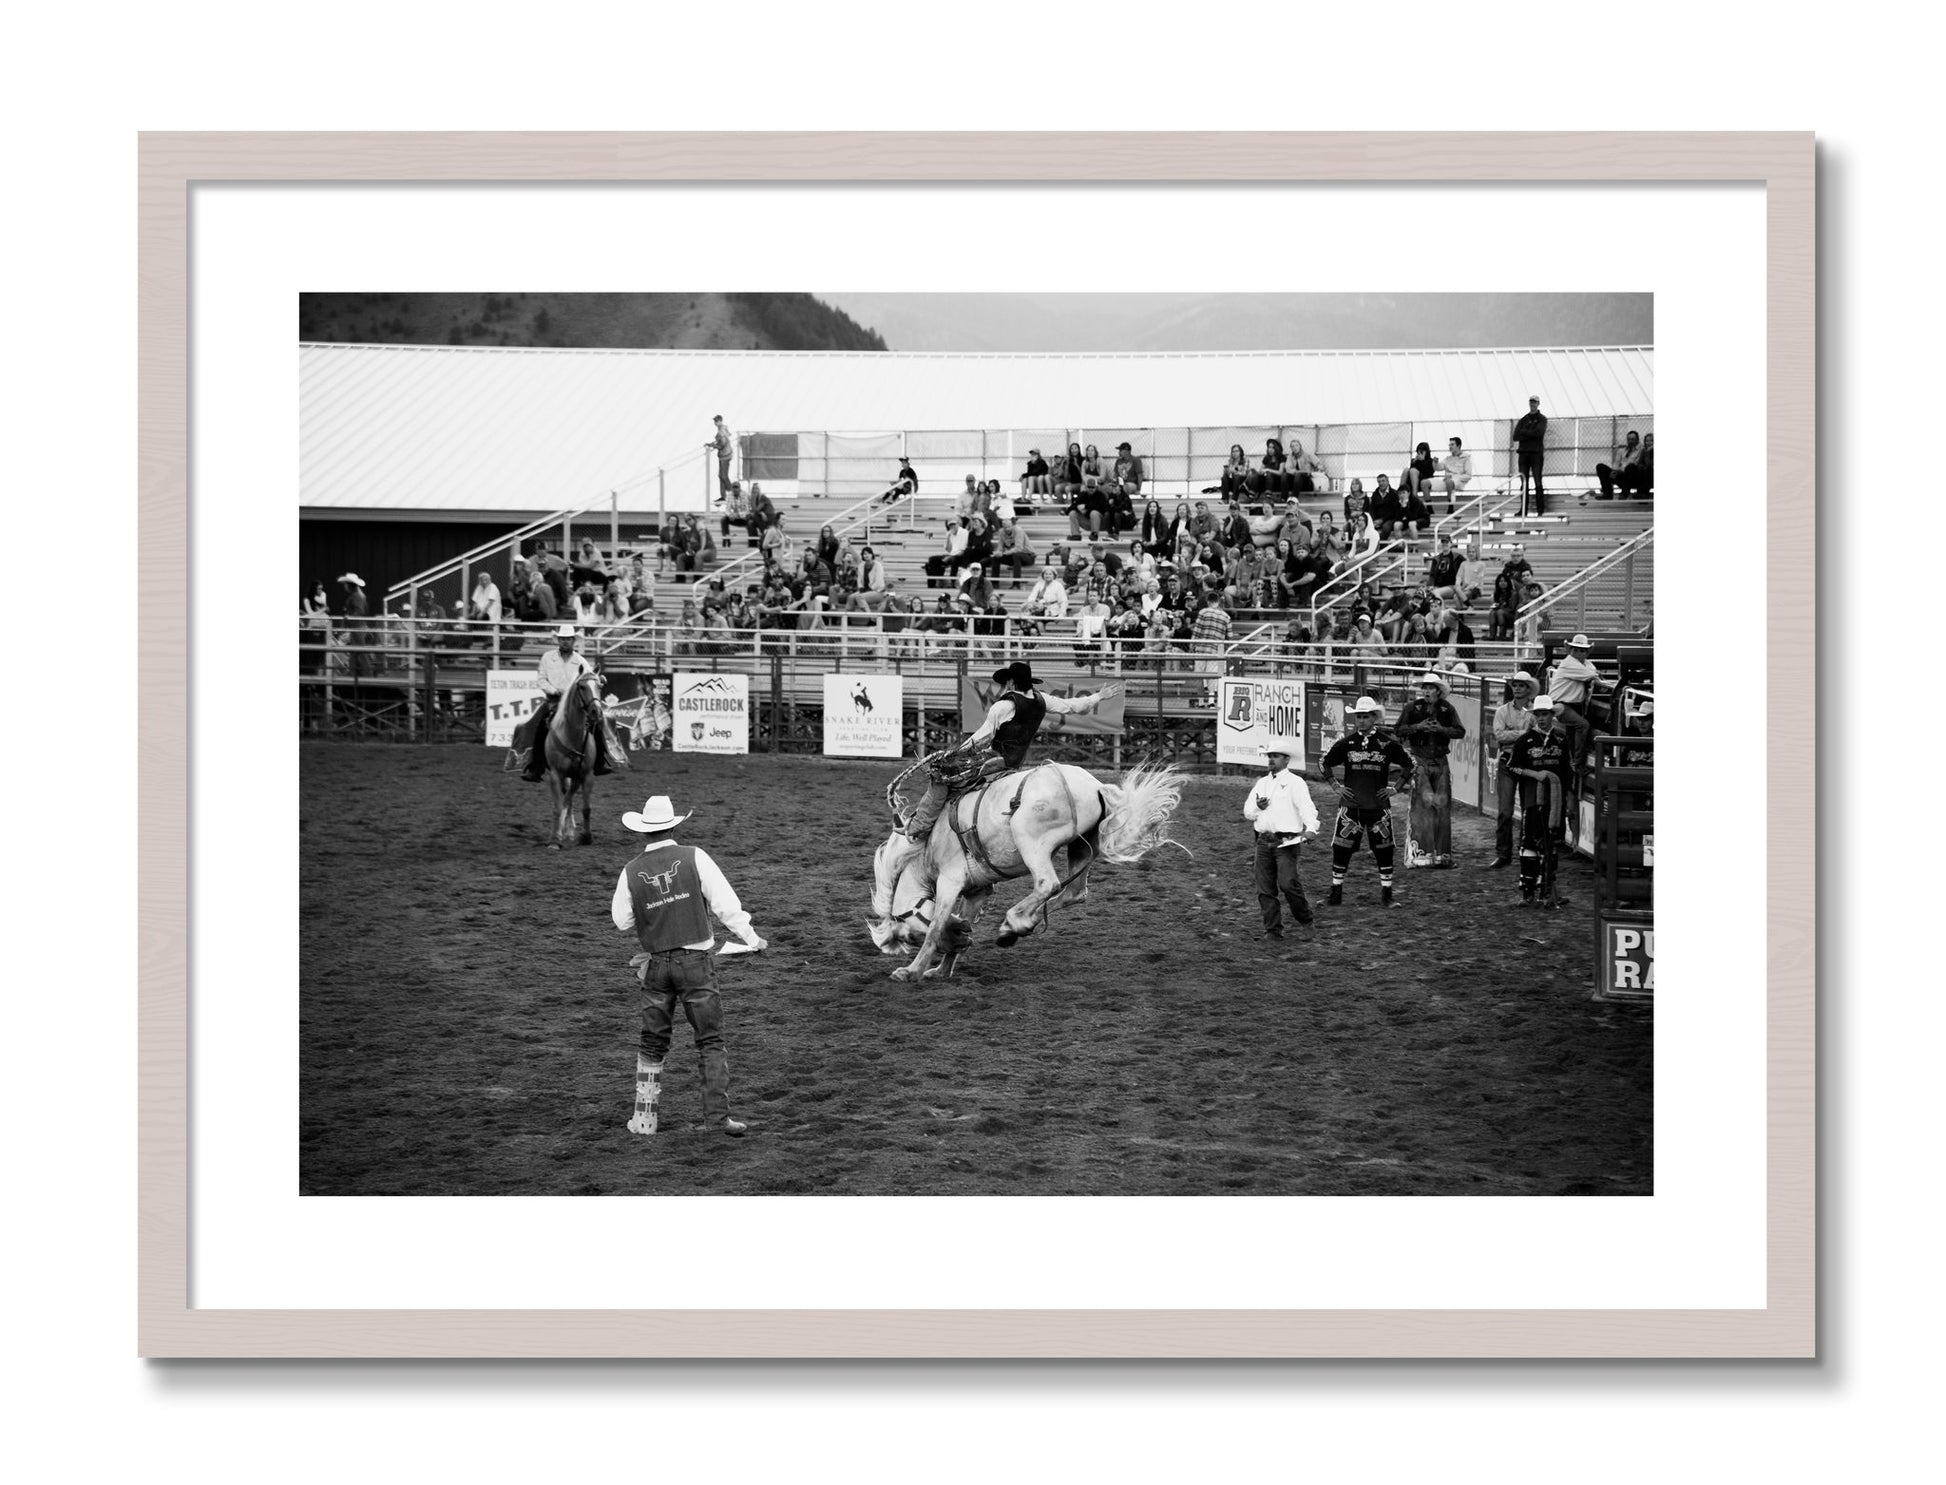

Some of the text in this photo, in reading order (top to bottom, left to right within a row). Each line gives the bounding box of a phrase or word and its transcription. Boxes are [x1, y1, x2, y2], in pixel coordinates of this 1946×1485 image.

[1255, 684, 1301, 705] RANCH
[679, 698, 744, 712] CASTLEROCK
[1228, 695, 1251, 722] R
[825, 716, 901, 725] SNAKE RIVER
[1269, 705, 1301, 738] HOME
[709, 727, 732, 739] Jeep
